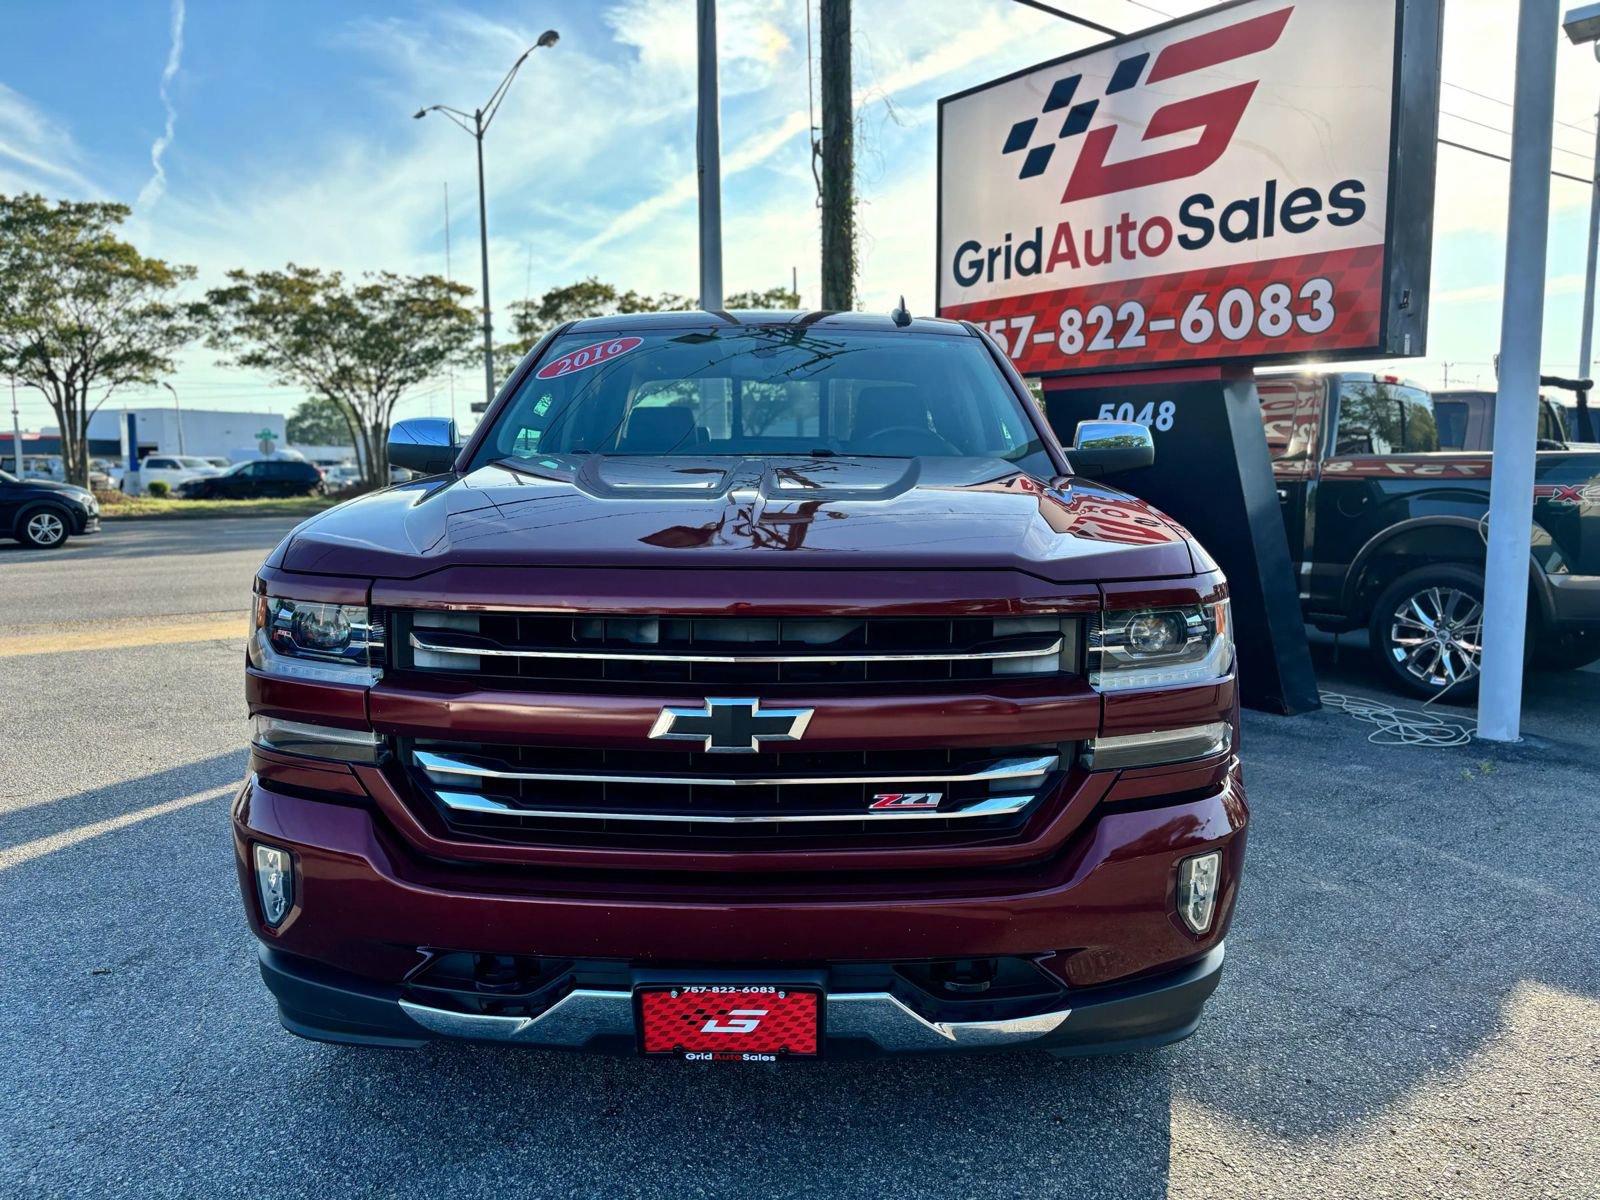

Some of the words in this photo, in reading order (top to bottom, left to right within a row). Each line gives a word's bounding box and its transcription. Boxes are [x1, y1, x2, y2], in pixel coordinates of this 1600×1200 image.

[952, 179, 1367, 288] GridAutoSales
[556, 340, 623, 376] 2016
[868, 792, 944, 809] Z71
[682, 986, 776, 994] 757-822-6083
[685, 1052, 776, 1062] GridAutoSales
